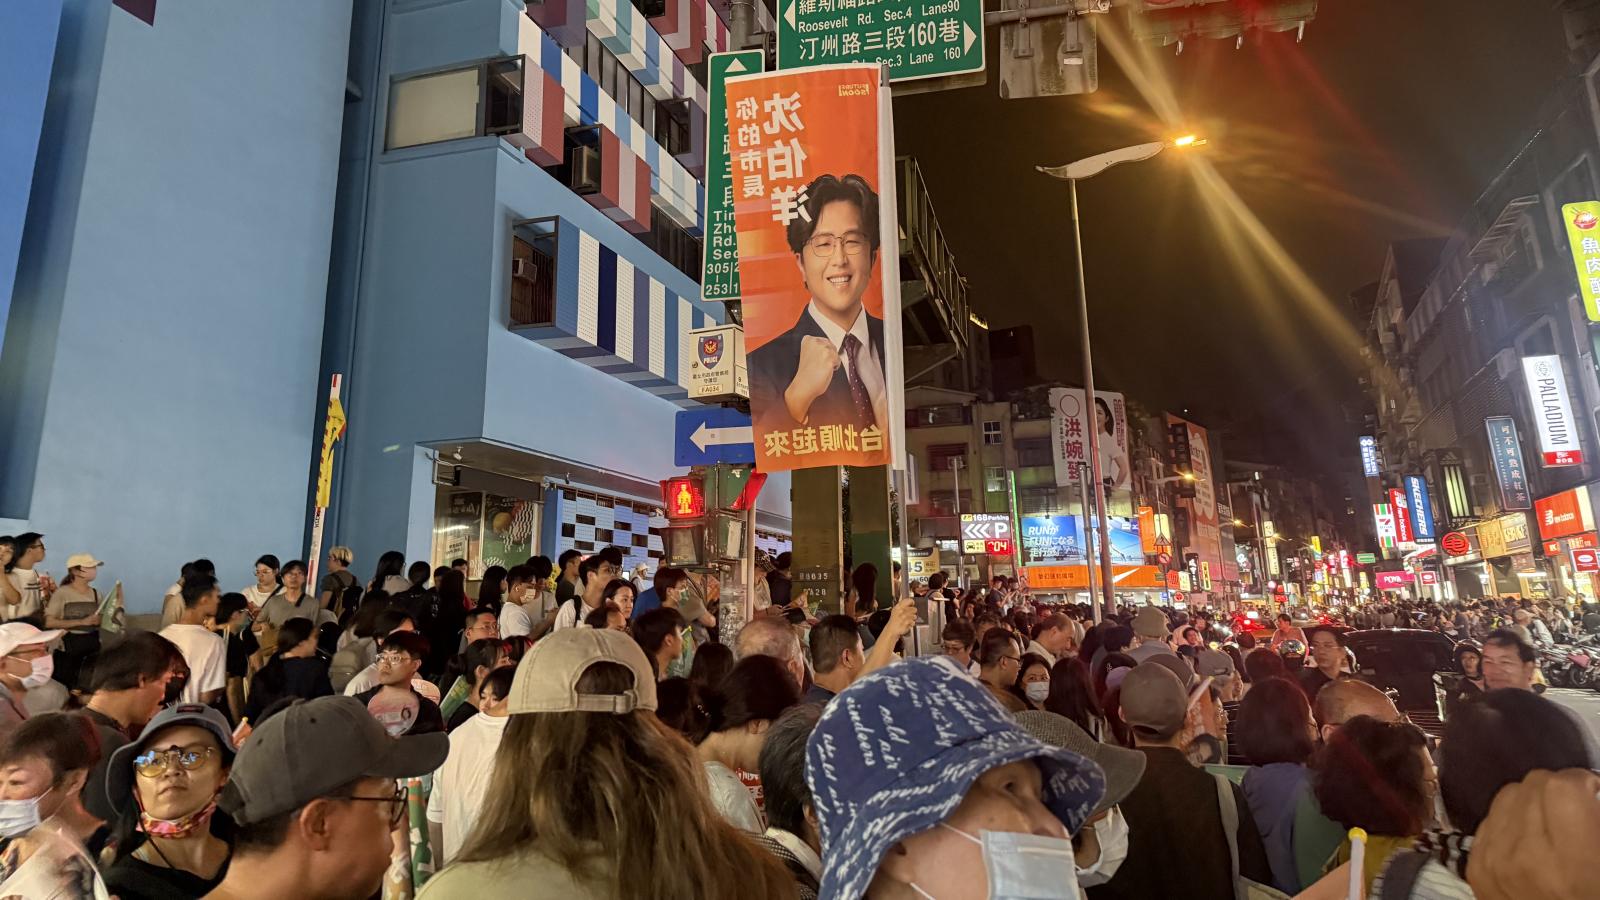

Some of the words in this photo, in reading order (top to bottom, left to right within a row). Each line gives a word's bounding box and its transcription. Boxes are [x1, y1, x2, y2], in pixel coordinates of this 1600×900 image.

[798, 18, 848, 33] Roosevelt
[857, 13, 875, 26] Rd.
[884, 6, 913, 22] Sec.4
[922, 0, 961, 16] Lane90
[799, 17, 961, 60] 汀州路三段160巷
[909, 52, 934, 65] Lane
[943, 46, 961, 60] 160
[713, 235, 736, 248] Rd.
[706, 263, 730, 274] 305
[705, 283, 728, 295] 253
[1537, 378, 1569, 445] PALLADIUM
[1410, 476, 1428, 536] SKECHERS
[994, 522, 1008, 539] P
